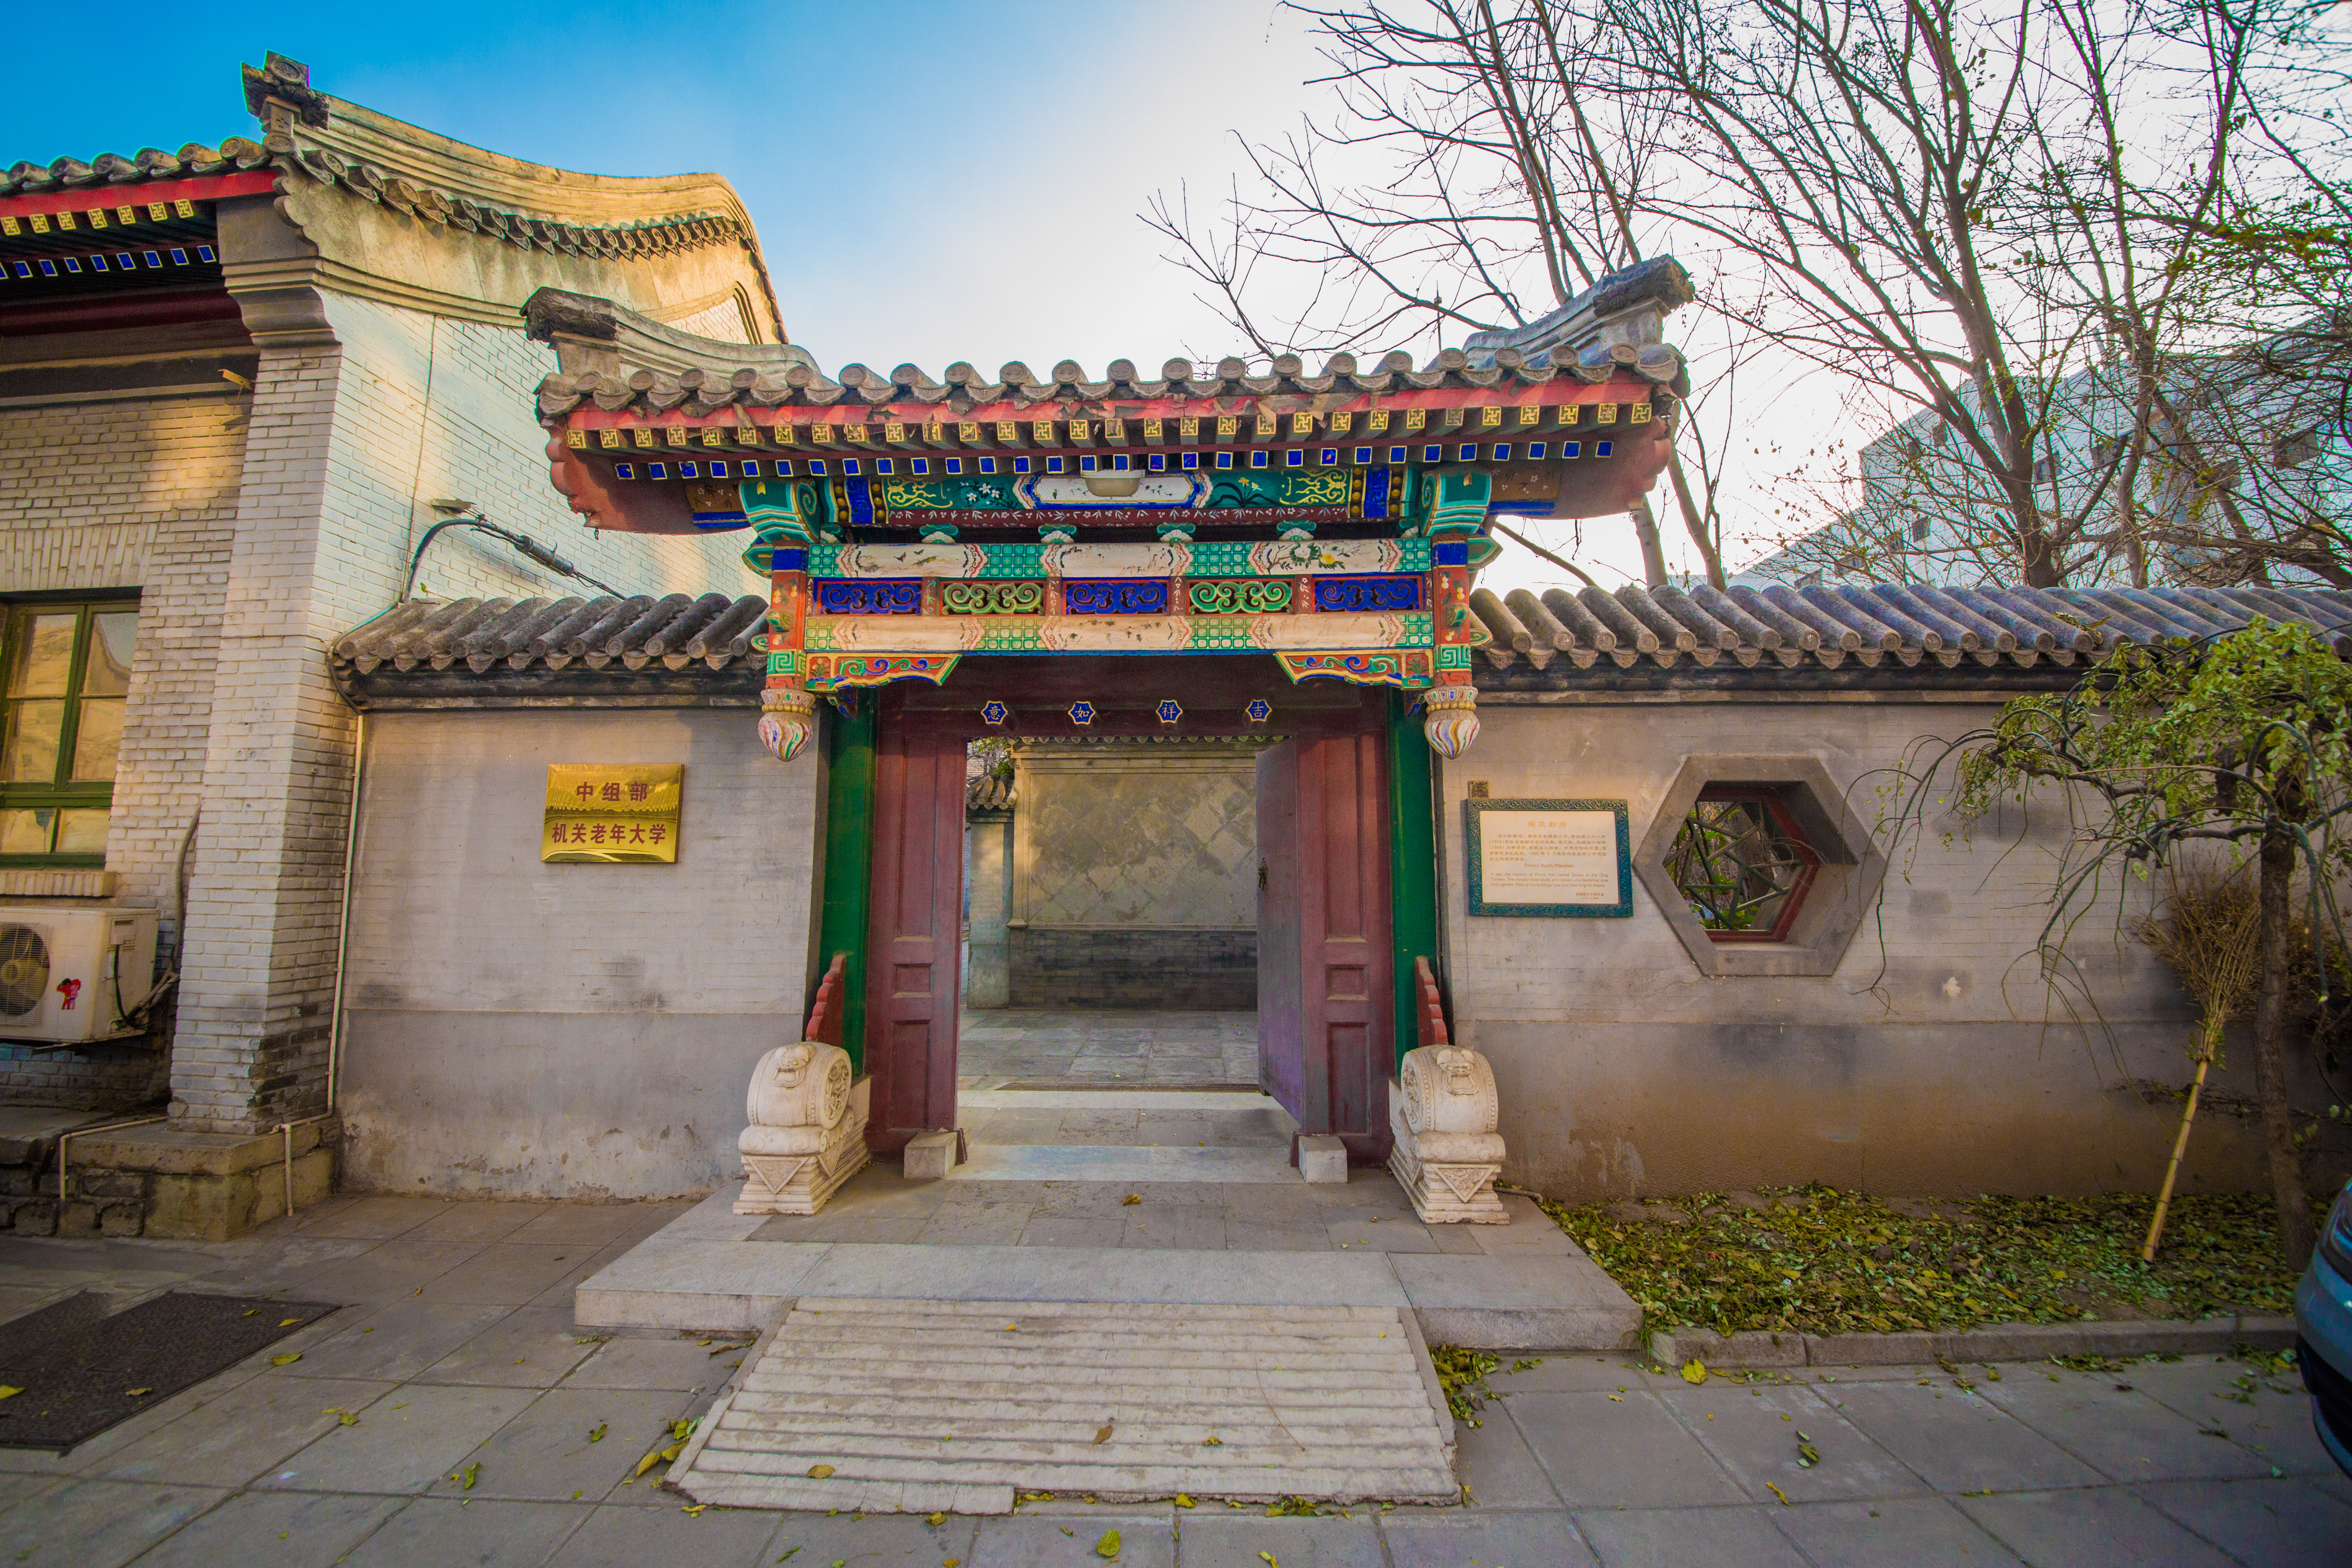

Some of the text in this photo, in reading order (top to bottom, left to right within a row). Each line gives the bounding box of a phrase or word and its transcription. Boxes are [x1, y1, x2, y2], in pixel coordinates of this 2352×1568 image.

[987, 704, 1264, 720] 意 如 祥 吉
[576, 781, 648, 802] 中组部
[552, 822, 666, 844] 机关老年大学
